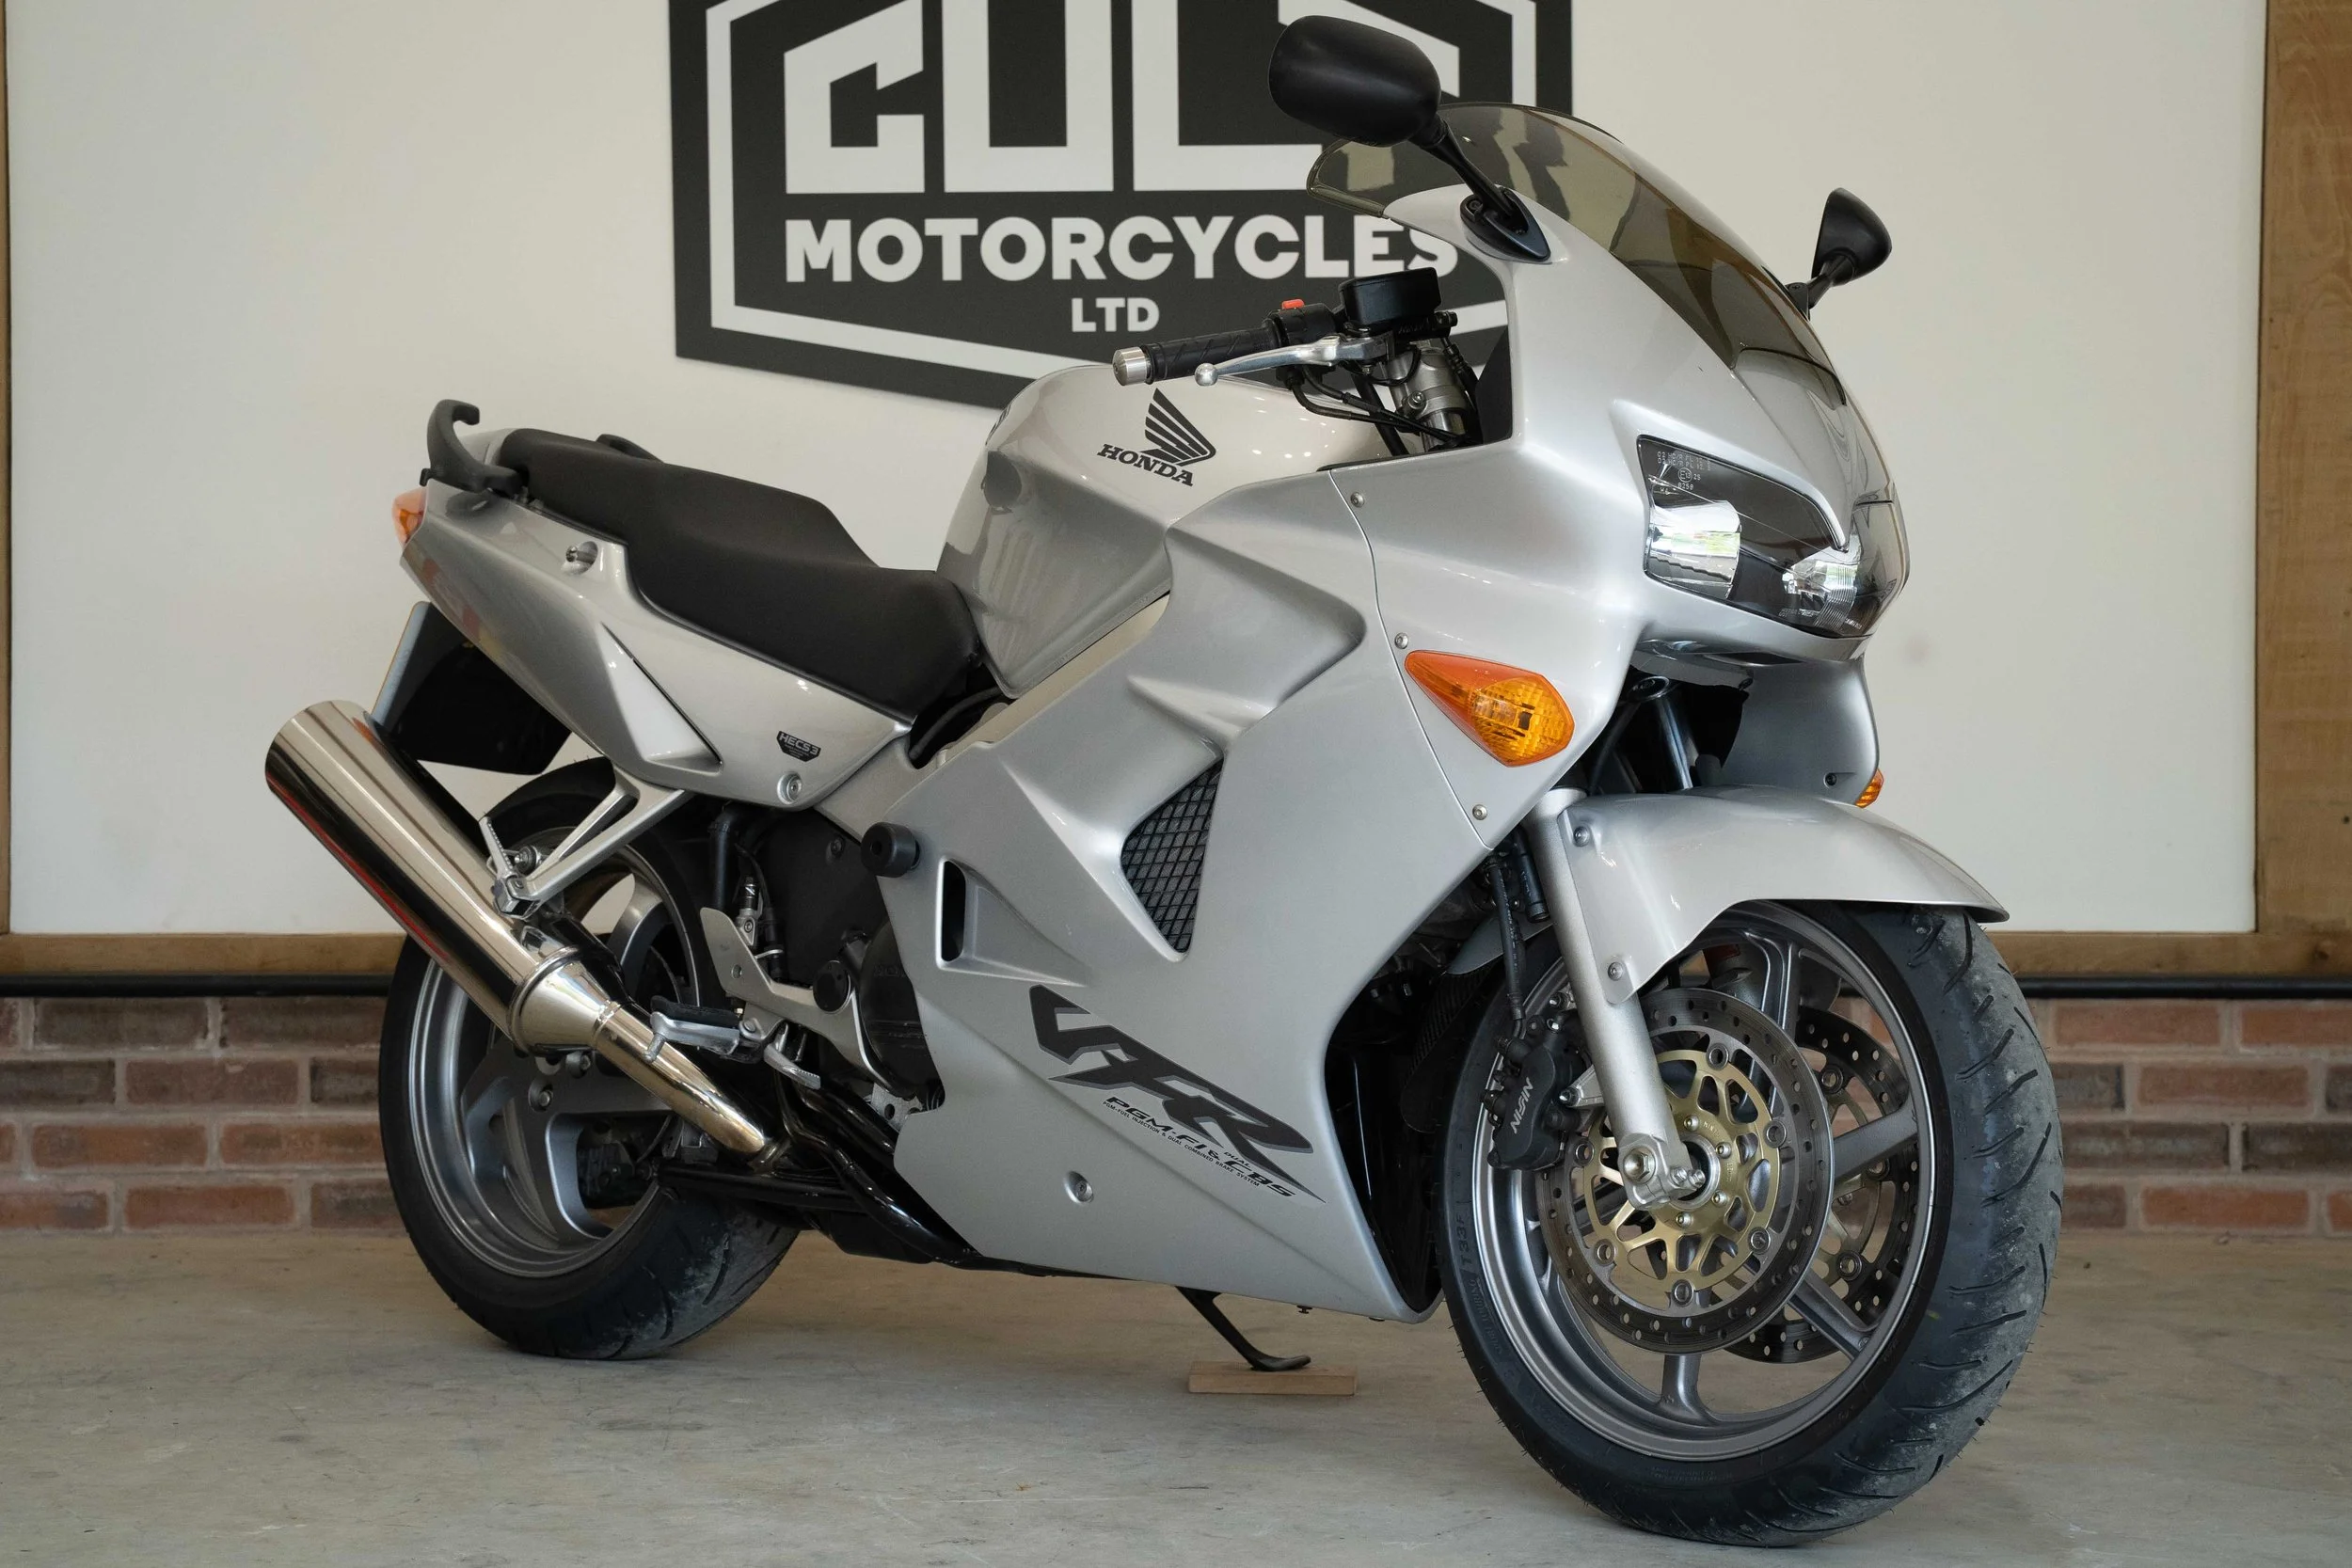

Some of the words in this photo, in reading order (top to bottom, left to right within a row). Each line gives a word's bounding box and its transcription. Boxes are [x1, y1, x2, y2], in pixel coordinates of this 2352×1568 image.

[785, 214, 1458, 284] MOTORCYCLES
[1071, 297, 1160, 334] LTD
[1096, 443, 1194, 487] HONDA
[1103, 1101, 1130, 1118] PGM-FUEL
[1132, 1116, 1160, 1133] INJECTION
[1168, 1135, 1182, 1146] DUAL
[1184, 1145, 1214, 1163] COMBINED
[1216, 1161, 1234, 1173] BRAKE
[1236, 1172, 1260, 1187] SYSTEM
[1224, 1151, 1251, 1168] DUAL
[1224, 1161, 1296, 1196] CBS
